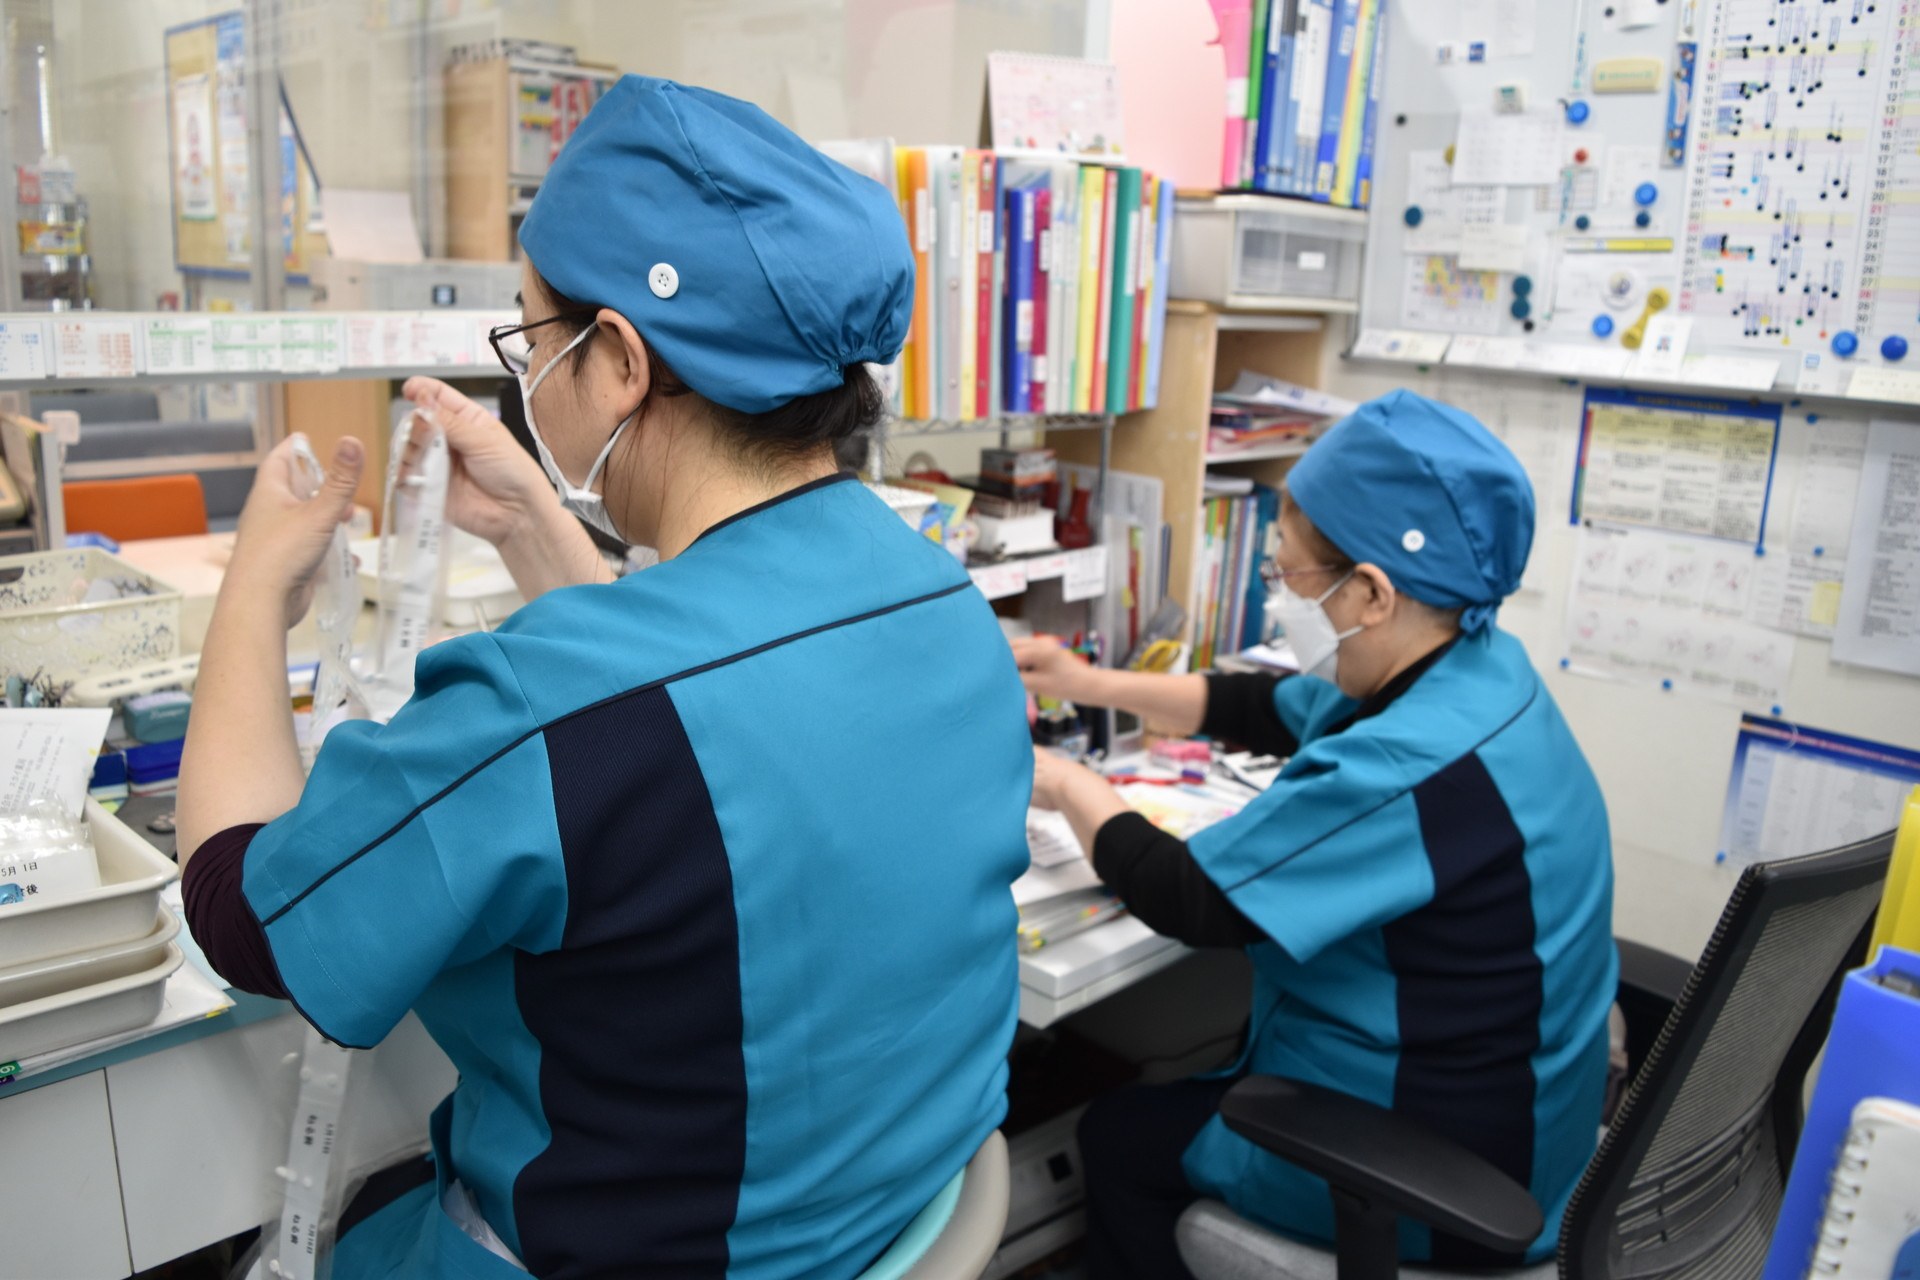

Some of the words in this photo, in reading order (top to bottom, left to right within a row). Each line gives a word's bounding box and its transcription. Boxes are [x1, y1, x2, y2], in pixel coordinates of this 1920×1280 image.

[1902, 5, 1907, 14] 5
[1899, 17, 1905, 26] 6
[1898, 30, 1904, 39] 7
[1896, 43, 1902, 52] 8
[1894, 55, 1900, 64] 9
[1891, 68, 1901, 77] 10
[1890, 81, 1898, 89] 11
[1888, 94, 1897, 102] 12
[1885, 106, 1895, 114] 13
[1884, 118, 1893, 127] 14
[1882, 131, 1891, 139] 15
[1880, 143, 1890, 151] 16
[1878, 156, 1888, 164] 17
[1877, 168, 1887, 176] 18
[1875, 180, 1885, 189] 19
